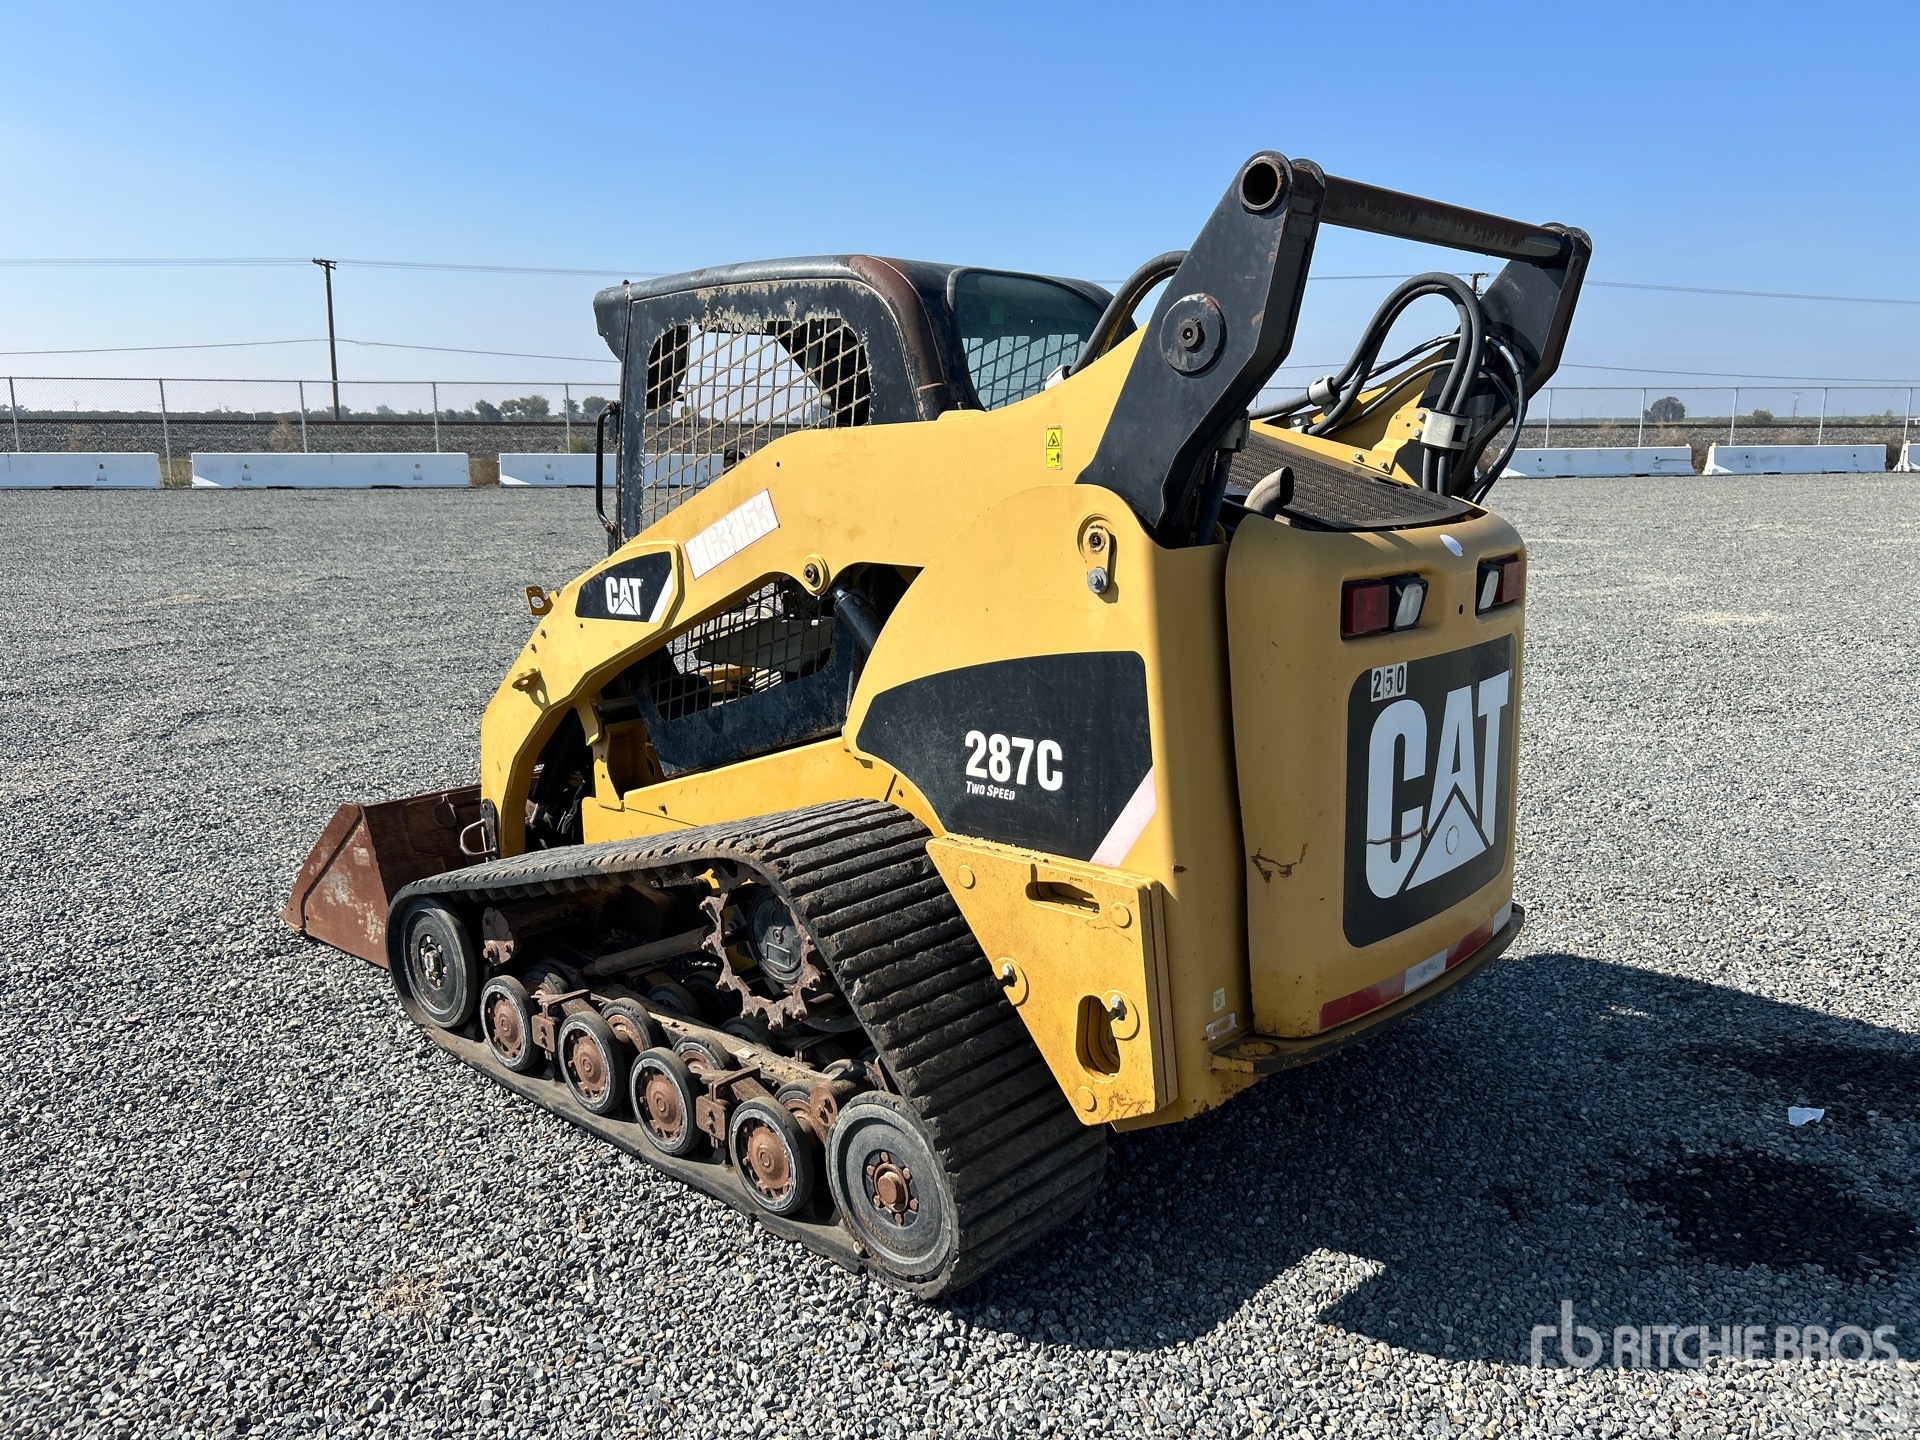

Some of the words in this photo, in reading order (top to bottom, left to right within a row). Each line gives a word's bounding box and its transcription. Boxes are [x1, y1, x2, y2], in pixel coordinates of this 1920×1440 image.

[605, 577, 642, 615] CAT
[1373, 665, 1404, 698] 250
[965, 730, 1063, 791] 287C
[1366, 670, 1509, 898] CAT
